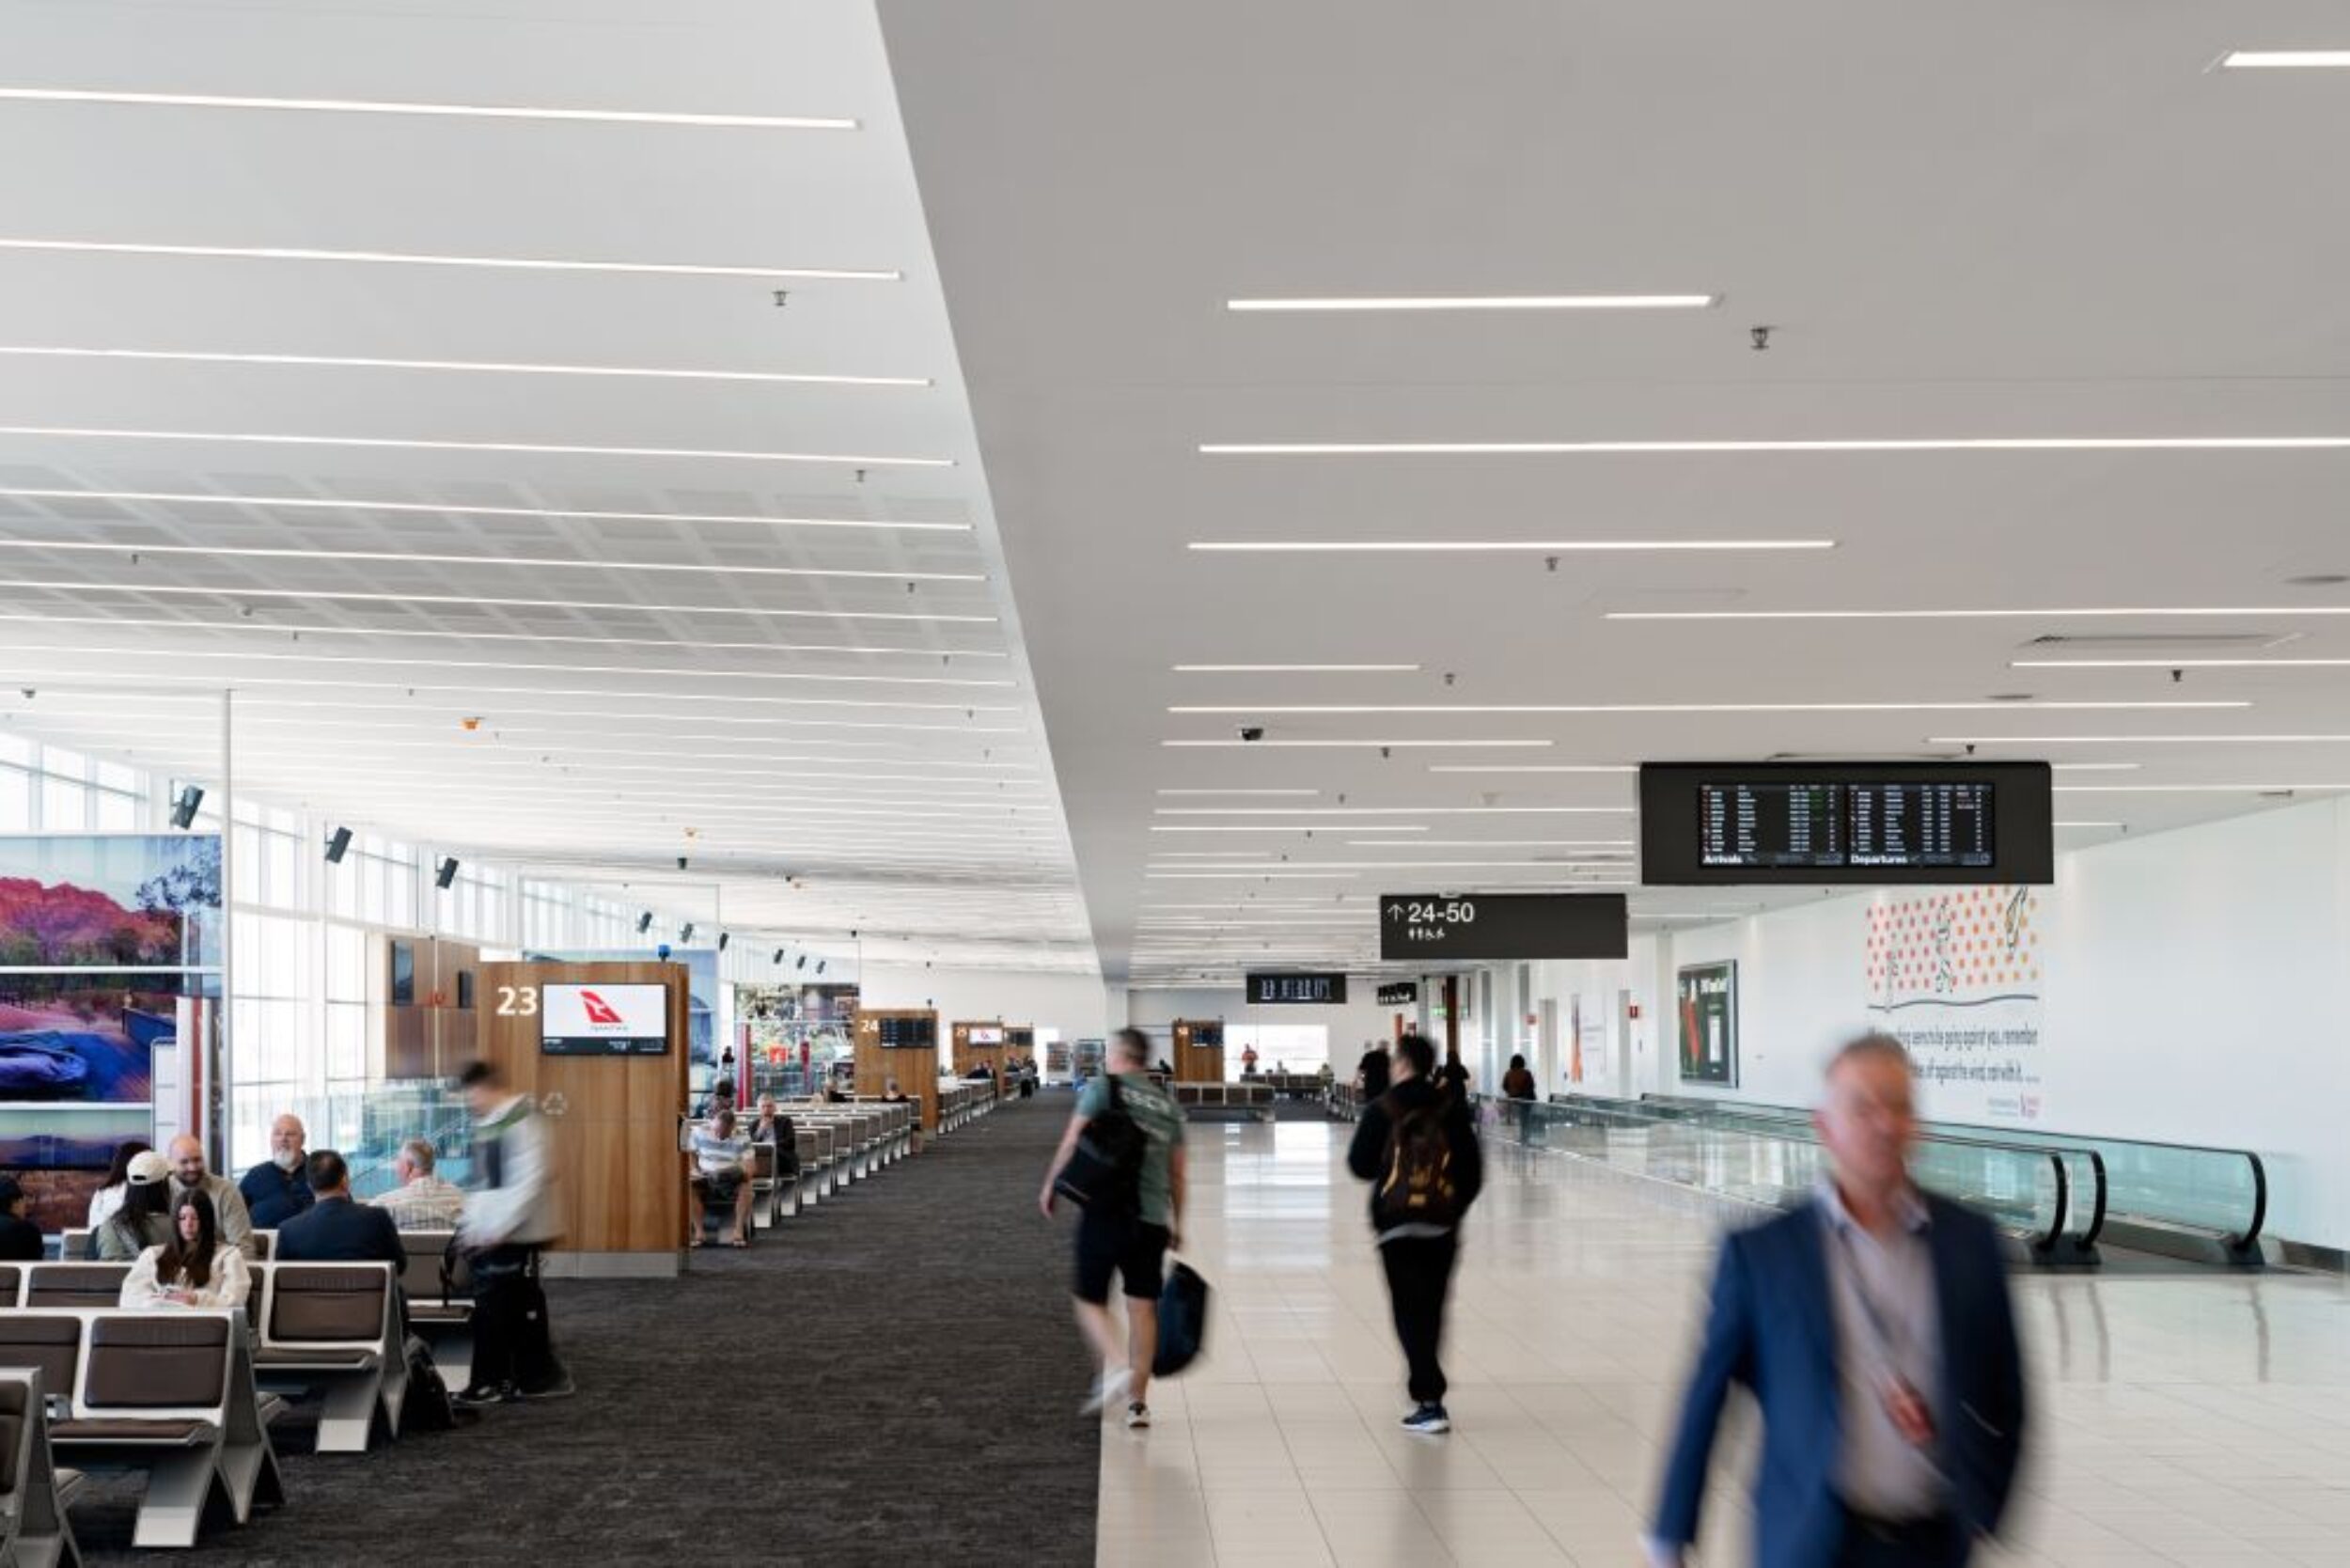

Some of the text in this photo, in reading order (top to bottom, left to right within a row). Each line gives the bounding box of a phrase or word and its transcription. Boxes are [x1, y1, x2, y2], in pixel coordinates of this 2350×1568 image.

[1702, 854, 1743, 864] Arrivals
[1850, 854, 1908, 866] Departures
[1408, 902, 1475, 922] 24-50
[496, 986, 538, 1016] 23
[859, 1019, 879, 1032] 24
